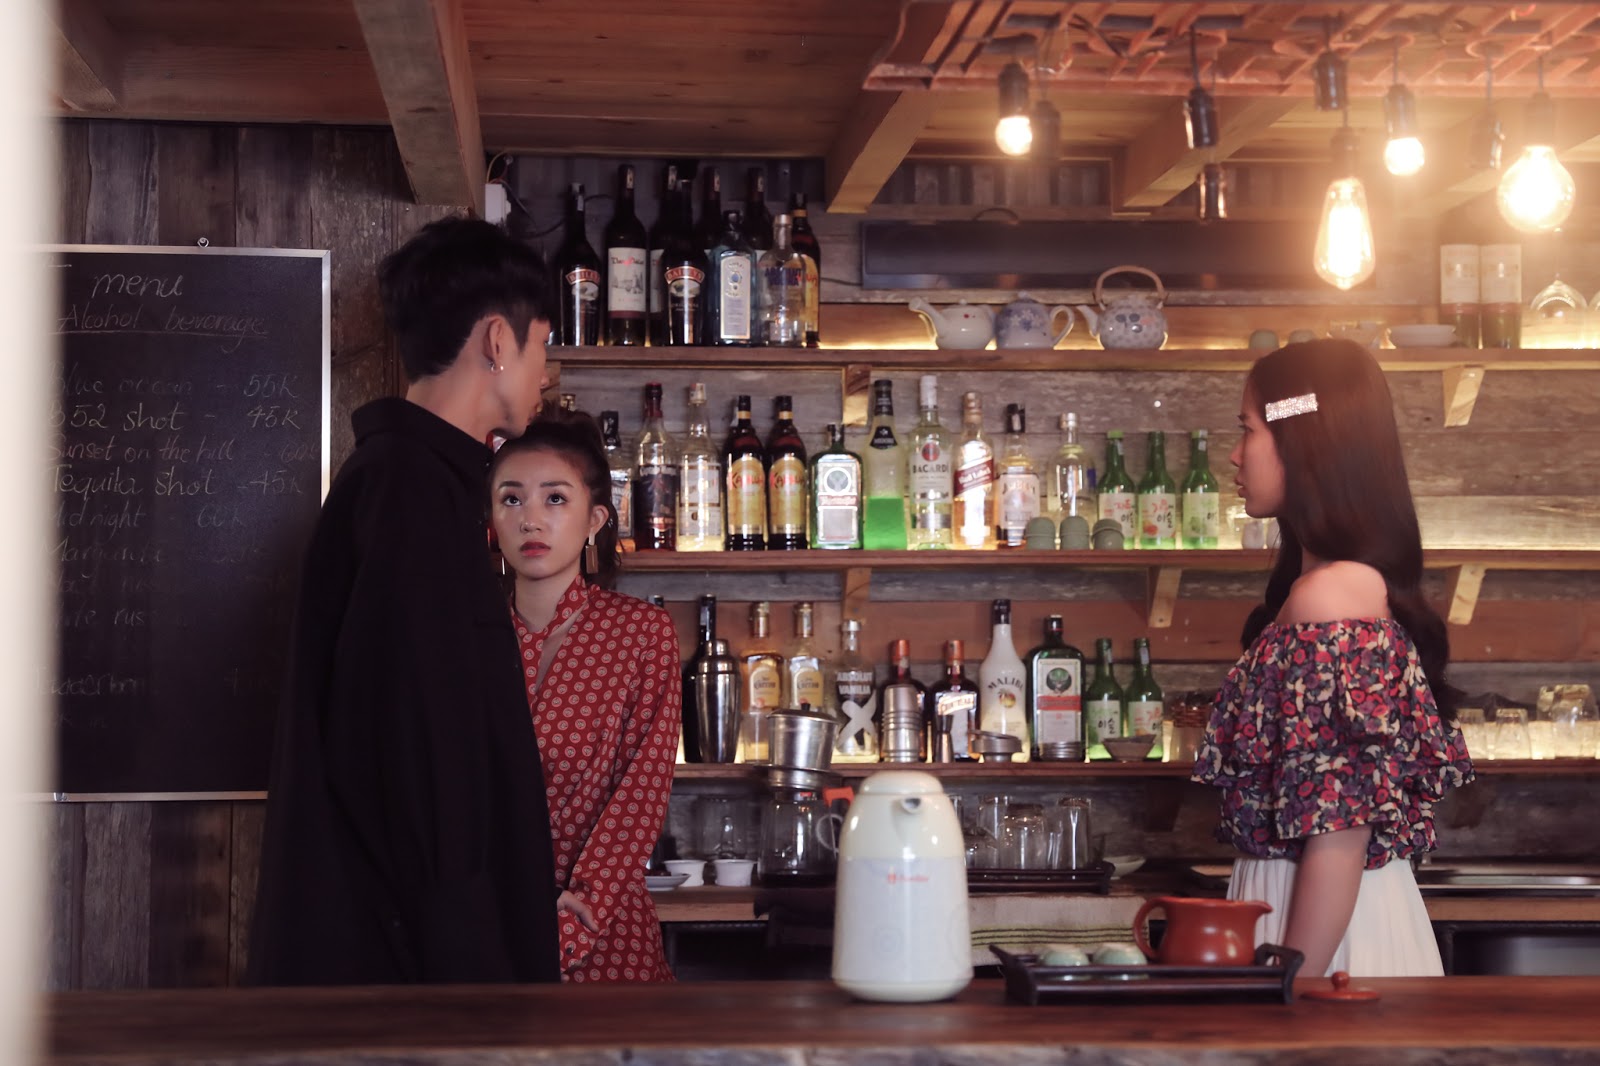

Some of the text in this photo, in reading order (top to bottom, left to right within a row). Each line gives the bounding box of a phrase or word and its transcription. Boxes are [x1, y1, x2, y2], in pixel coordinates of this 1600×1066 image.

[92, 273, 183, 298] menu
[58, 302, 268, 353] Alcohol beverage
[123, 402, 187, 432] shot
[124, 446, 150, 463] on
[159, 435, 190, 463] the
[50, 464, 143, 501] Tequila
[154, 466, 217, 496] shot
